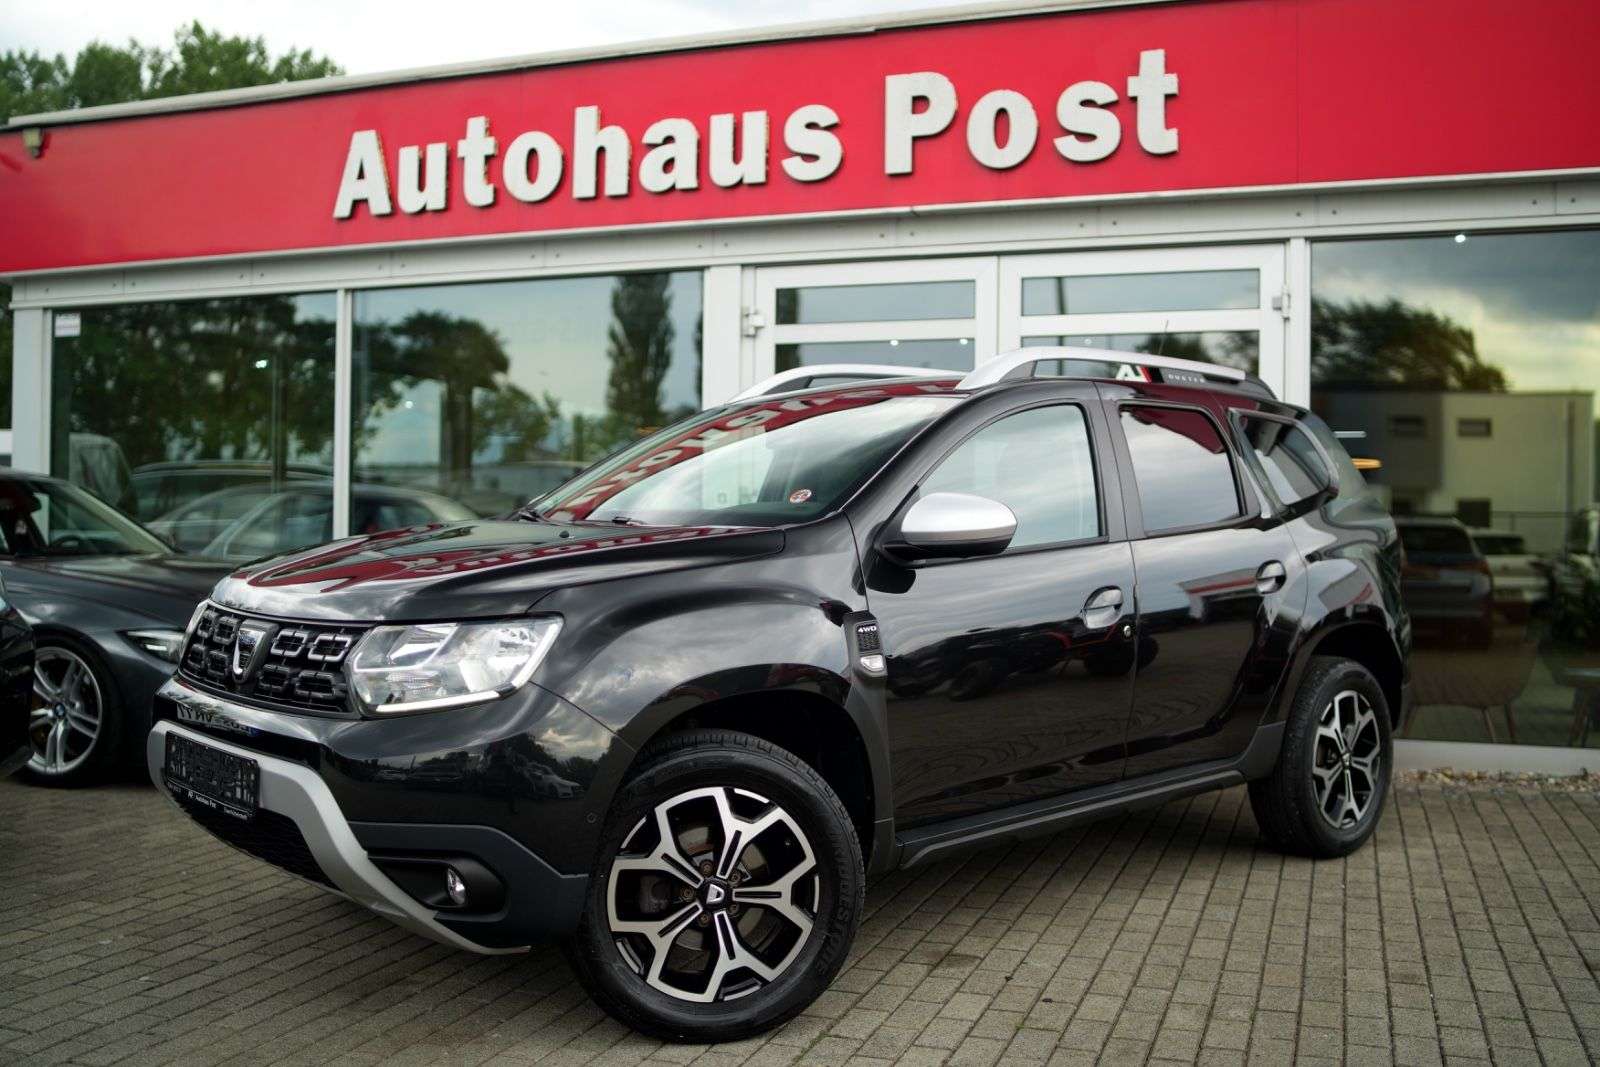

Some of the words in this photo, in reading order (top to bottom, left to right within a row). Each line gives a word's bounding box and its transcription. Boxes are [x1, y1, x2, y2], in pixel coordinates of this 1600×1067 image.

[333, 103, 842, 220] Autohaus
[884, 48, 1179, 175] Post
[857, 625, 877, 633] 4WD
